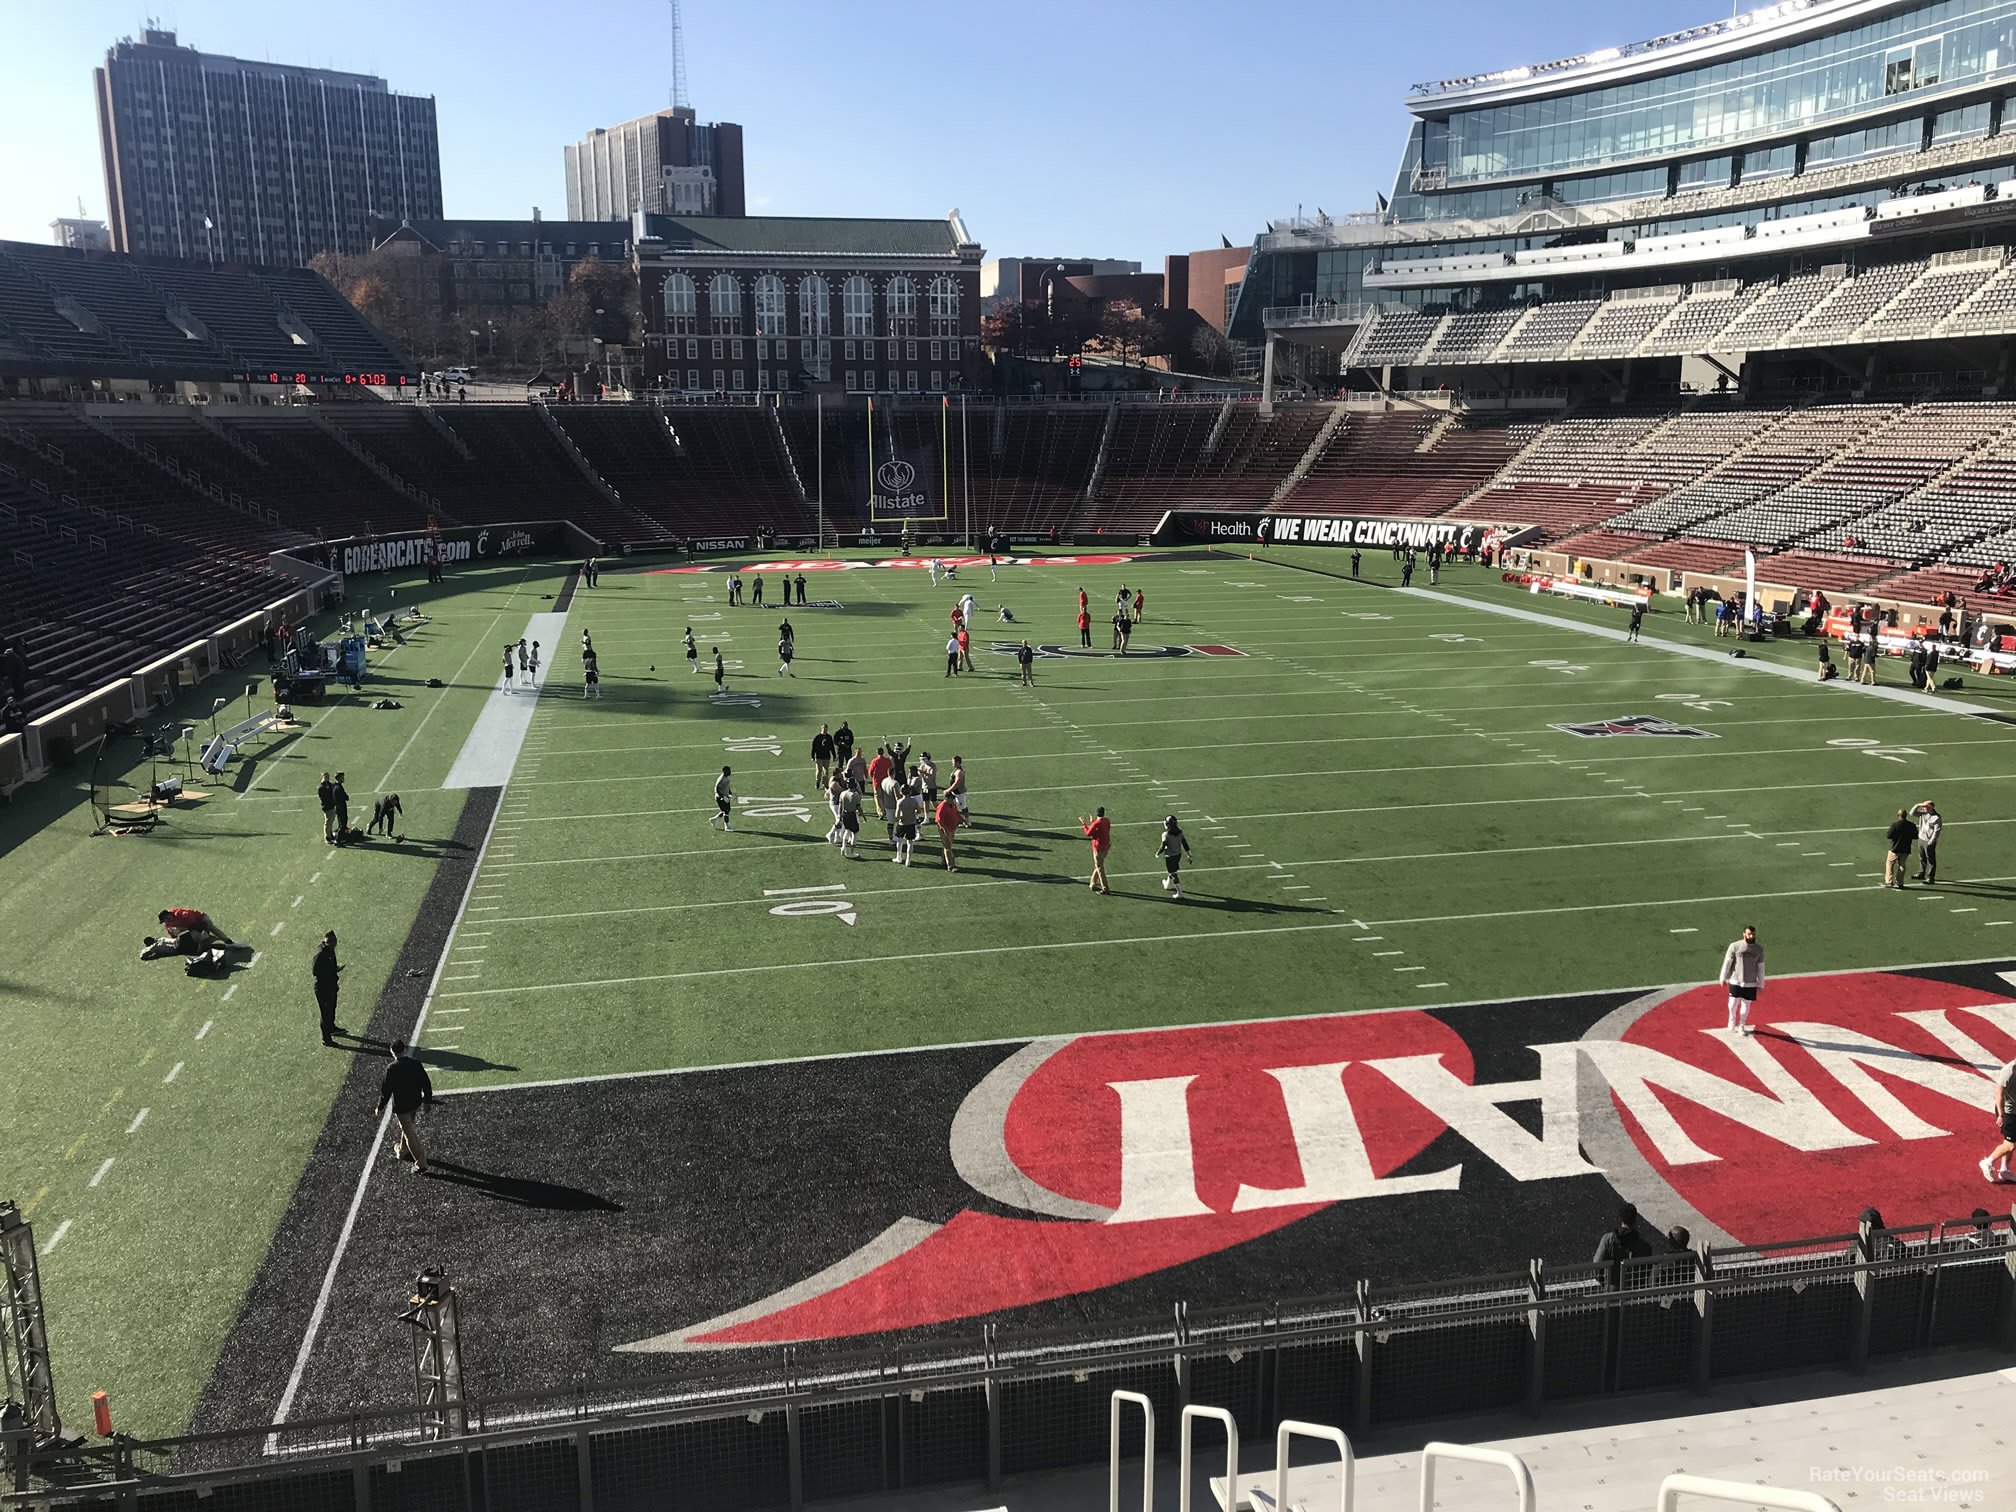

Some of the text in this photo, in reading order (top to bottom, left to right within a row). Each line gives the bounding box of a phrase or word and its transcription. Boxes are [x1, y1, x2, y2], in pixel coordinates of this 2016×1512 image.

[1068, 357, 1081, 368] 25
[270, 373, 278, 383] 10
[295, 373, 306, 383] 20
[359, 373, 386, 385] 67:03
[865, 493, 925, 509] Allstate
[1210, 520, 1251, 536] Health
[1273, 518, 1302, 541] WE
[1303, 519, 1351, 544] WEAR
[695, 540, 745, 551] NISSAN
[858, 536, 882, 546] meijer
[762, 882, 857, 918] 10
